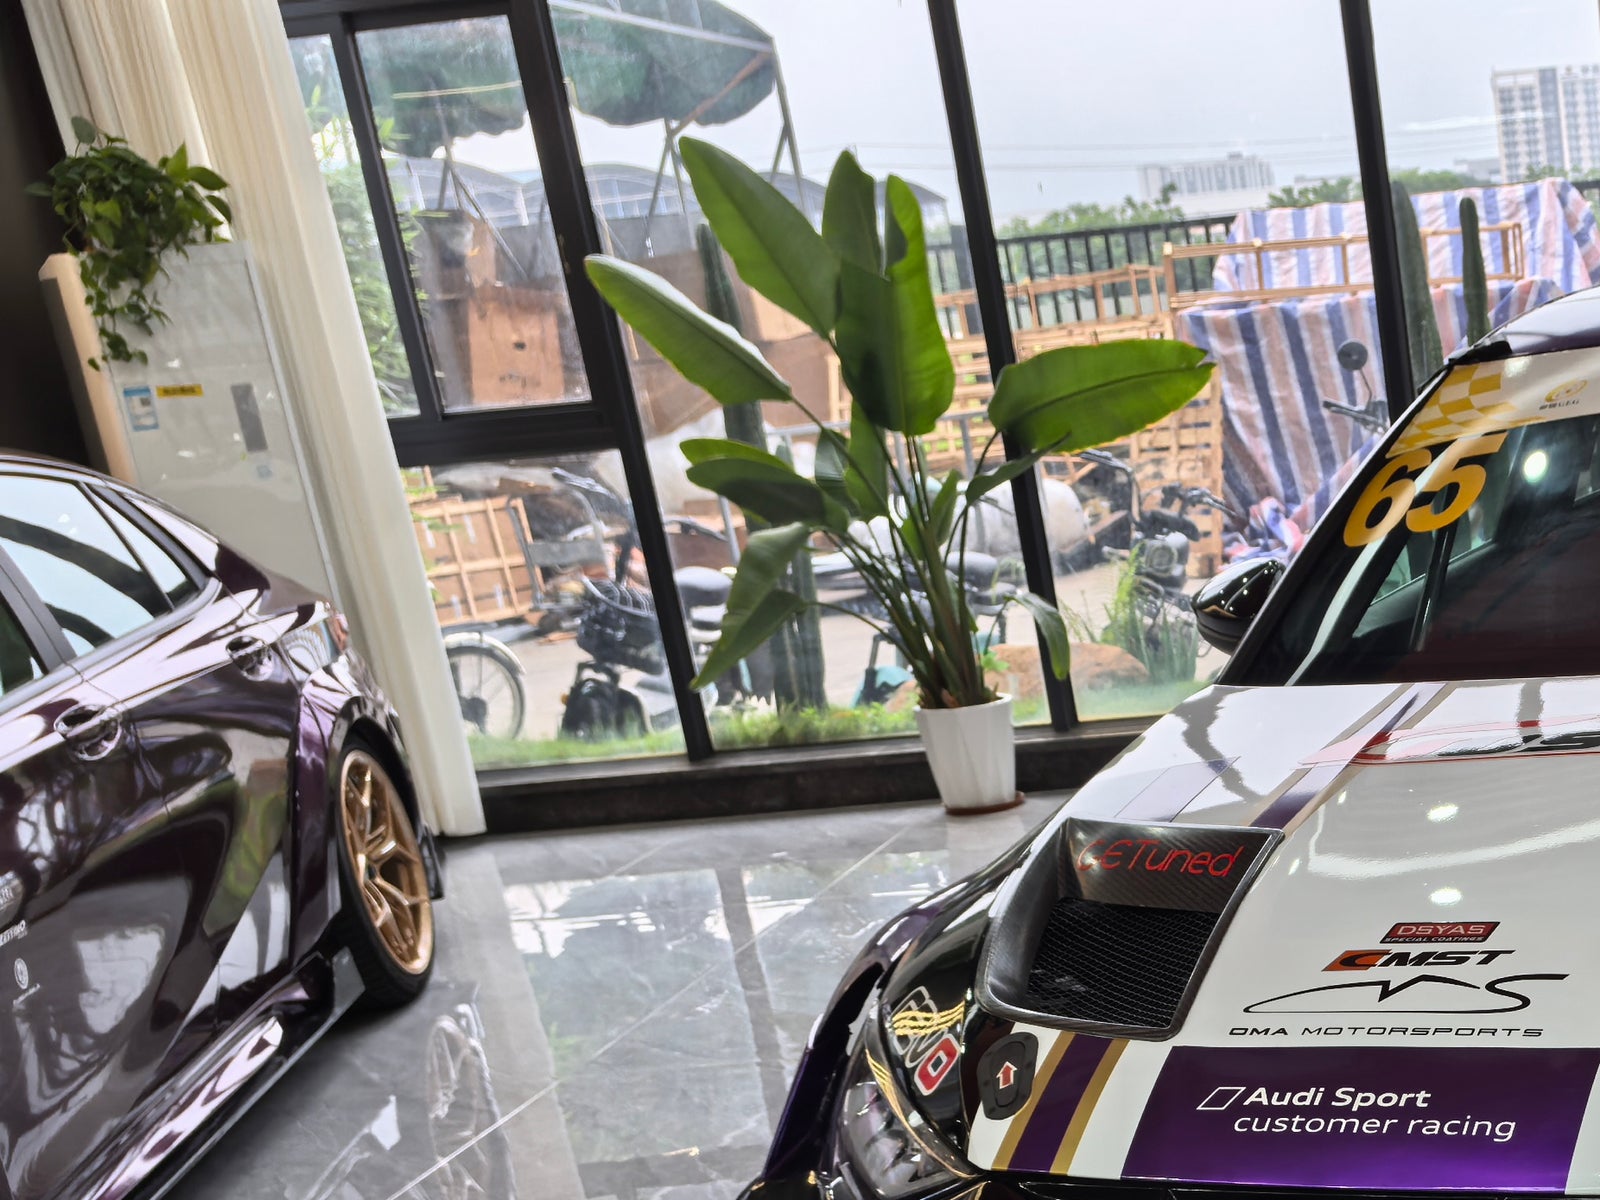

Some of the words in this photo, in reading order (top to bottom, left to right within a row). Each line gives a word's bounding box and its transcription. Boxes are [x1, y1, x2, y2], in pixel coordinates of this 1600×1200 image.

[1343, 432, 1508, 547] 65
[1397, 924, 1486, 936] DSYAS
[1339, 950, 1516, 968] CMST
[1301, 1026, 1544, 1038] MOTORSPORTS
[1243, 1087, 1325, 1106] Audi
[1331, 1087, 1431, 1112] Sport
[1234, 1115, 1398, 1135] customer
[1406, 1115, 1517, 1142] racing
